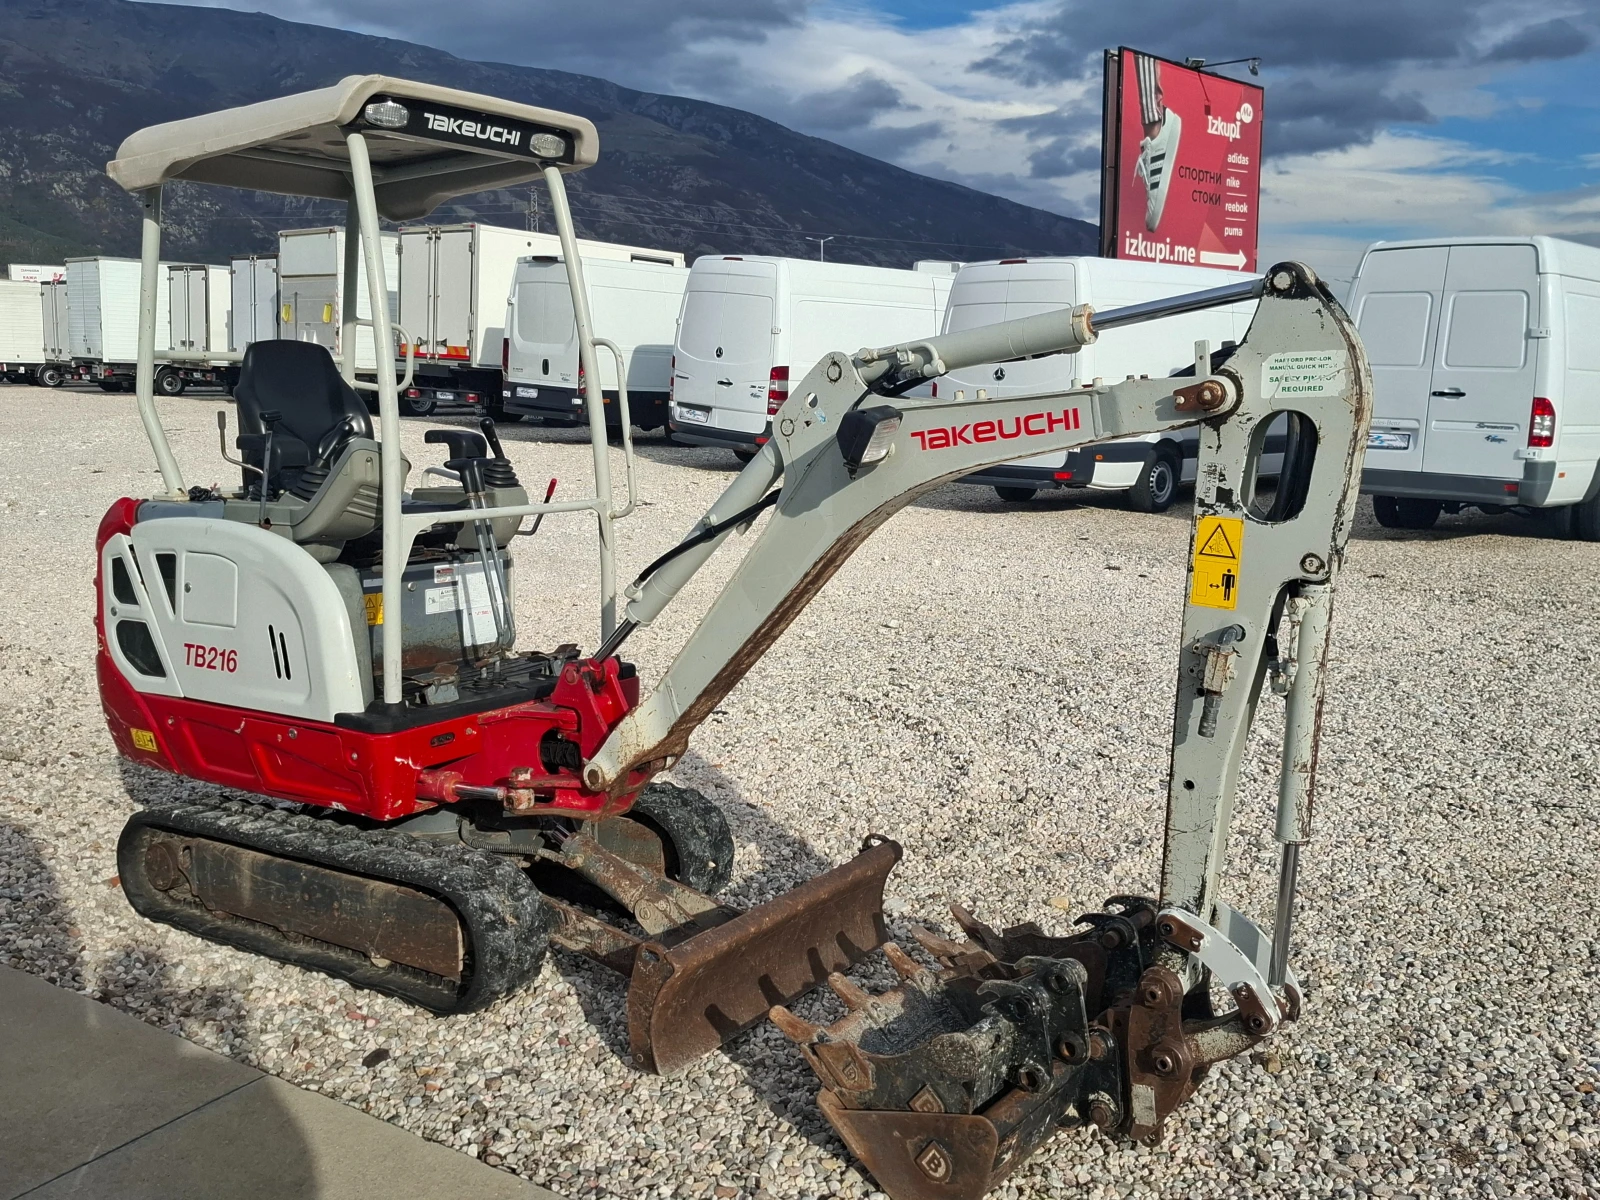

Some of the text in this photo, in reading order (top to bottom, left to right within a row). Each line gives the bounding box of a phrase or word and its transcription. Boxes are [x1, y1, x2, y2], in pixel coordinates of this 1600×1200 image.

[424, 112, 521, 146] TAKEUCHI
[1227, 152, 1249, 165] adidas
[1226, 176, 1240, 188] nike
[1225, 201, 1248, 213] reebok
[1224, 226, 1243, 237] puma
[1125, 230, 1196, 263] izkupi.me
[1281, 385, 1324, 393] REQUIRED
[911, 408, 1080, 451] TAKEUCHI
[184, 643, 238, 673] TB216
